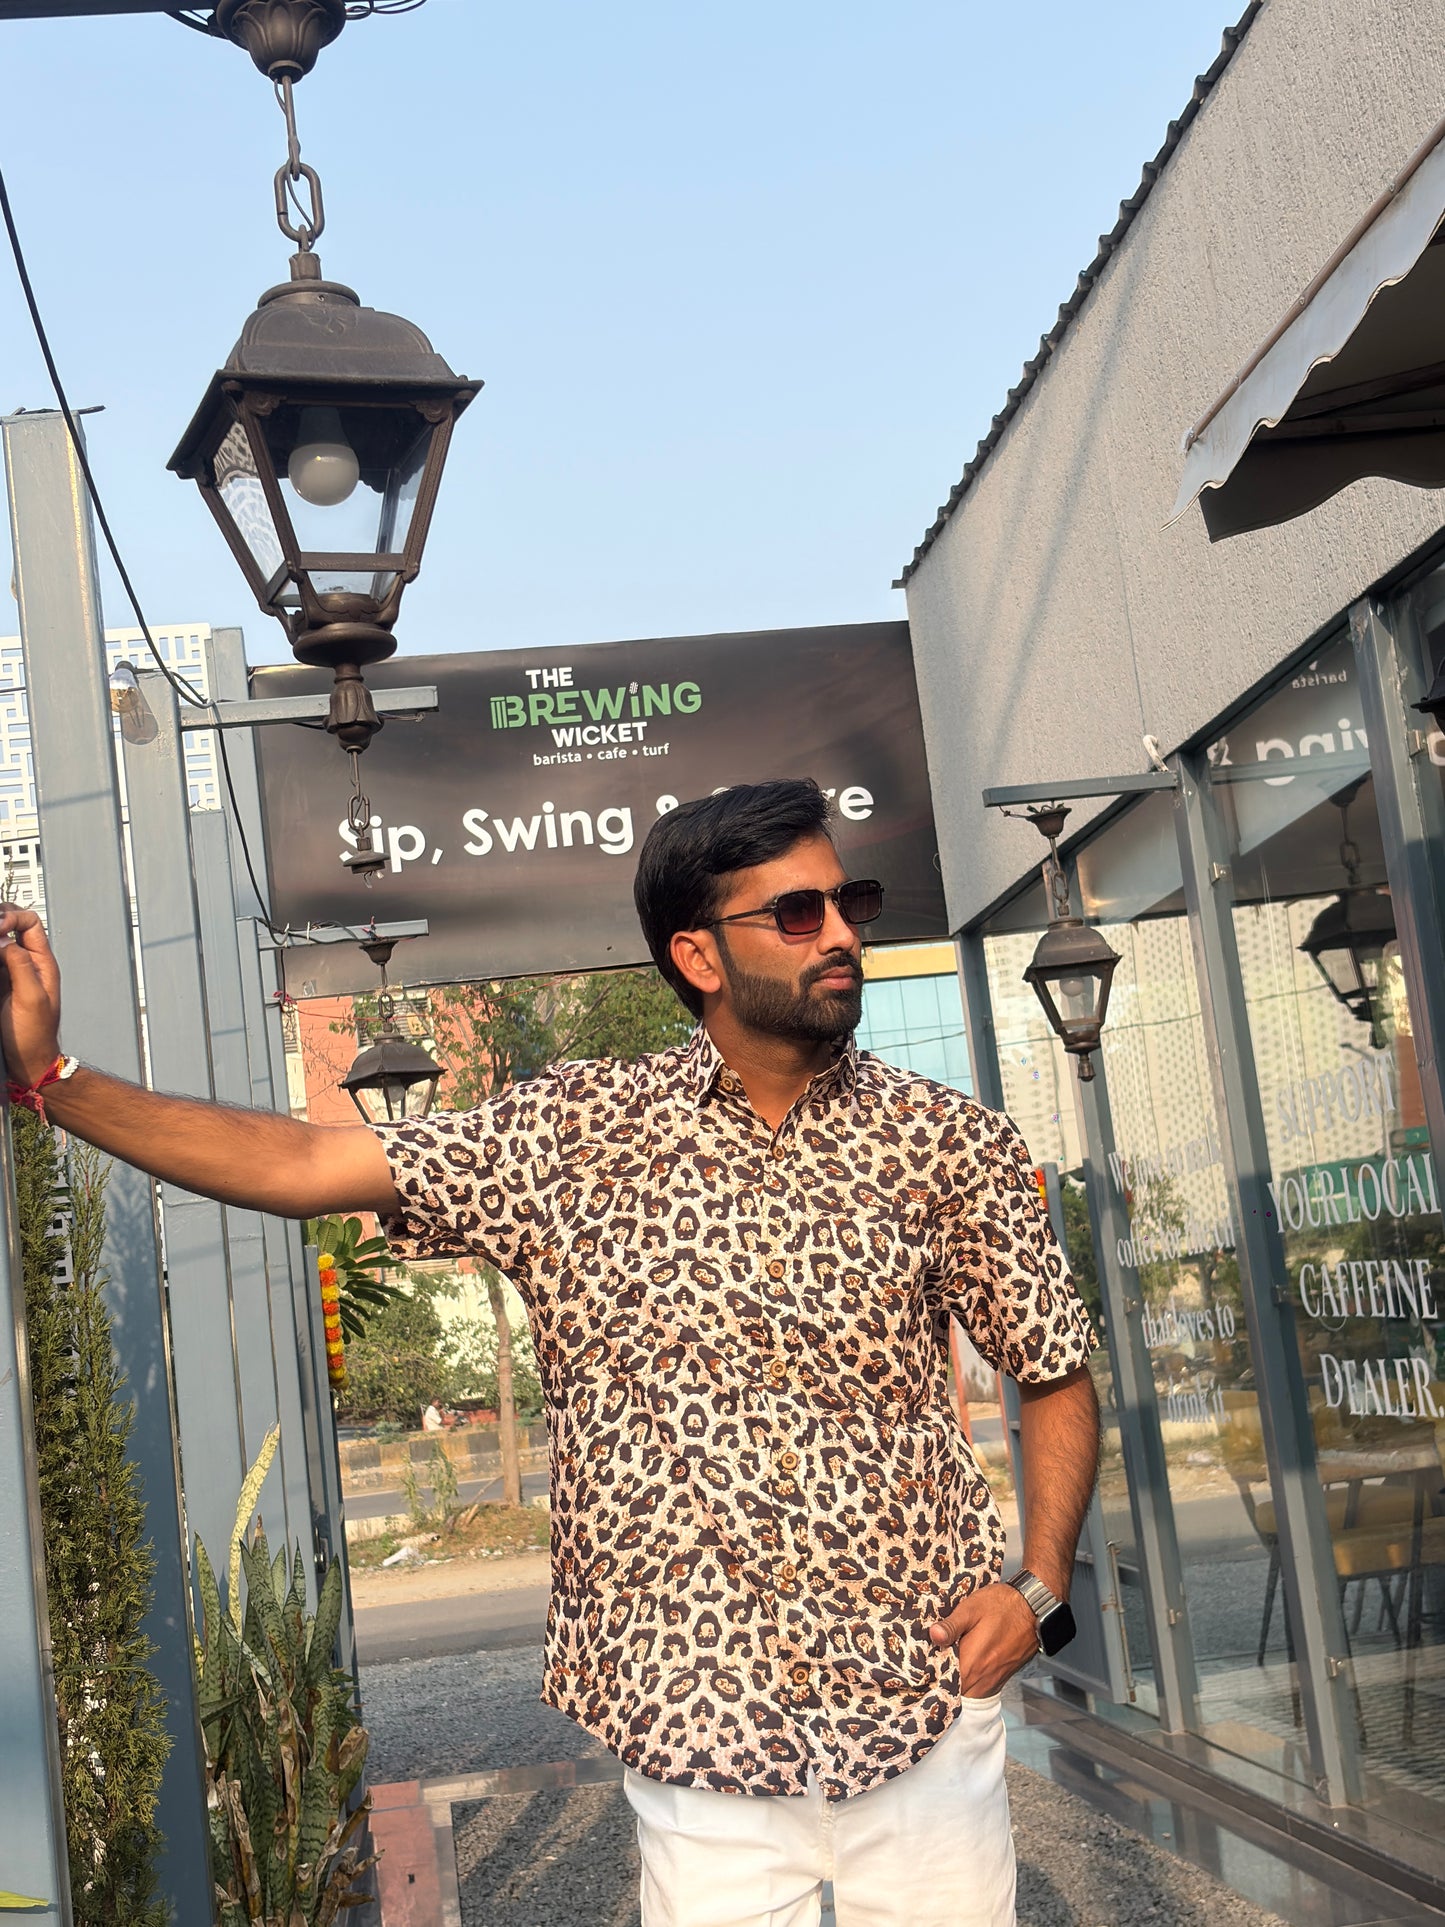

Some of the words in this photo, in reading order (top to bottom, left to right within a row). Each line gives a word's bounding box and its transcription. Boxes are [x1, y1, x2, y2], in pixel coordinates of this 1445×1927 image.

[525, 667, 574, 689] THE
[533, 752, 582, 766] barista
[597, 748, 627, 761] cafe
[642, 743, 670, 757] turf
[551, 721, 648, 748] WICKET
[338, 815, 443, 873] Sip,
[462, 801, 635, 857] Swing
[1276, 1052, 1396, 1144] SUPPORT
[1267, 1169, 1342, 1233] YOUR
[1117, 1216, 1159, 1268] coffee
[1300, 1258, 1438, 1322] CAFFEINE
[1170, 1296, 1215, 1343] loves
[1215, 1300, 1235, 1340] to
[1167, 1374, 1212, 1423] drink
[1319, 1353, 1445, 1418] DEALER.
